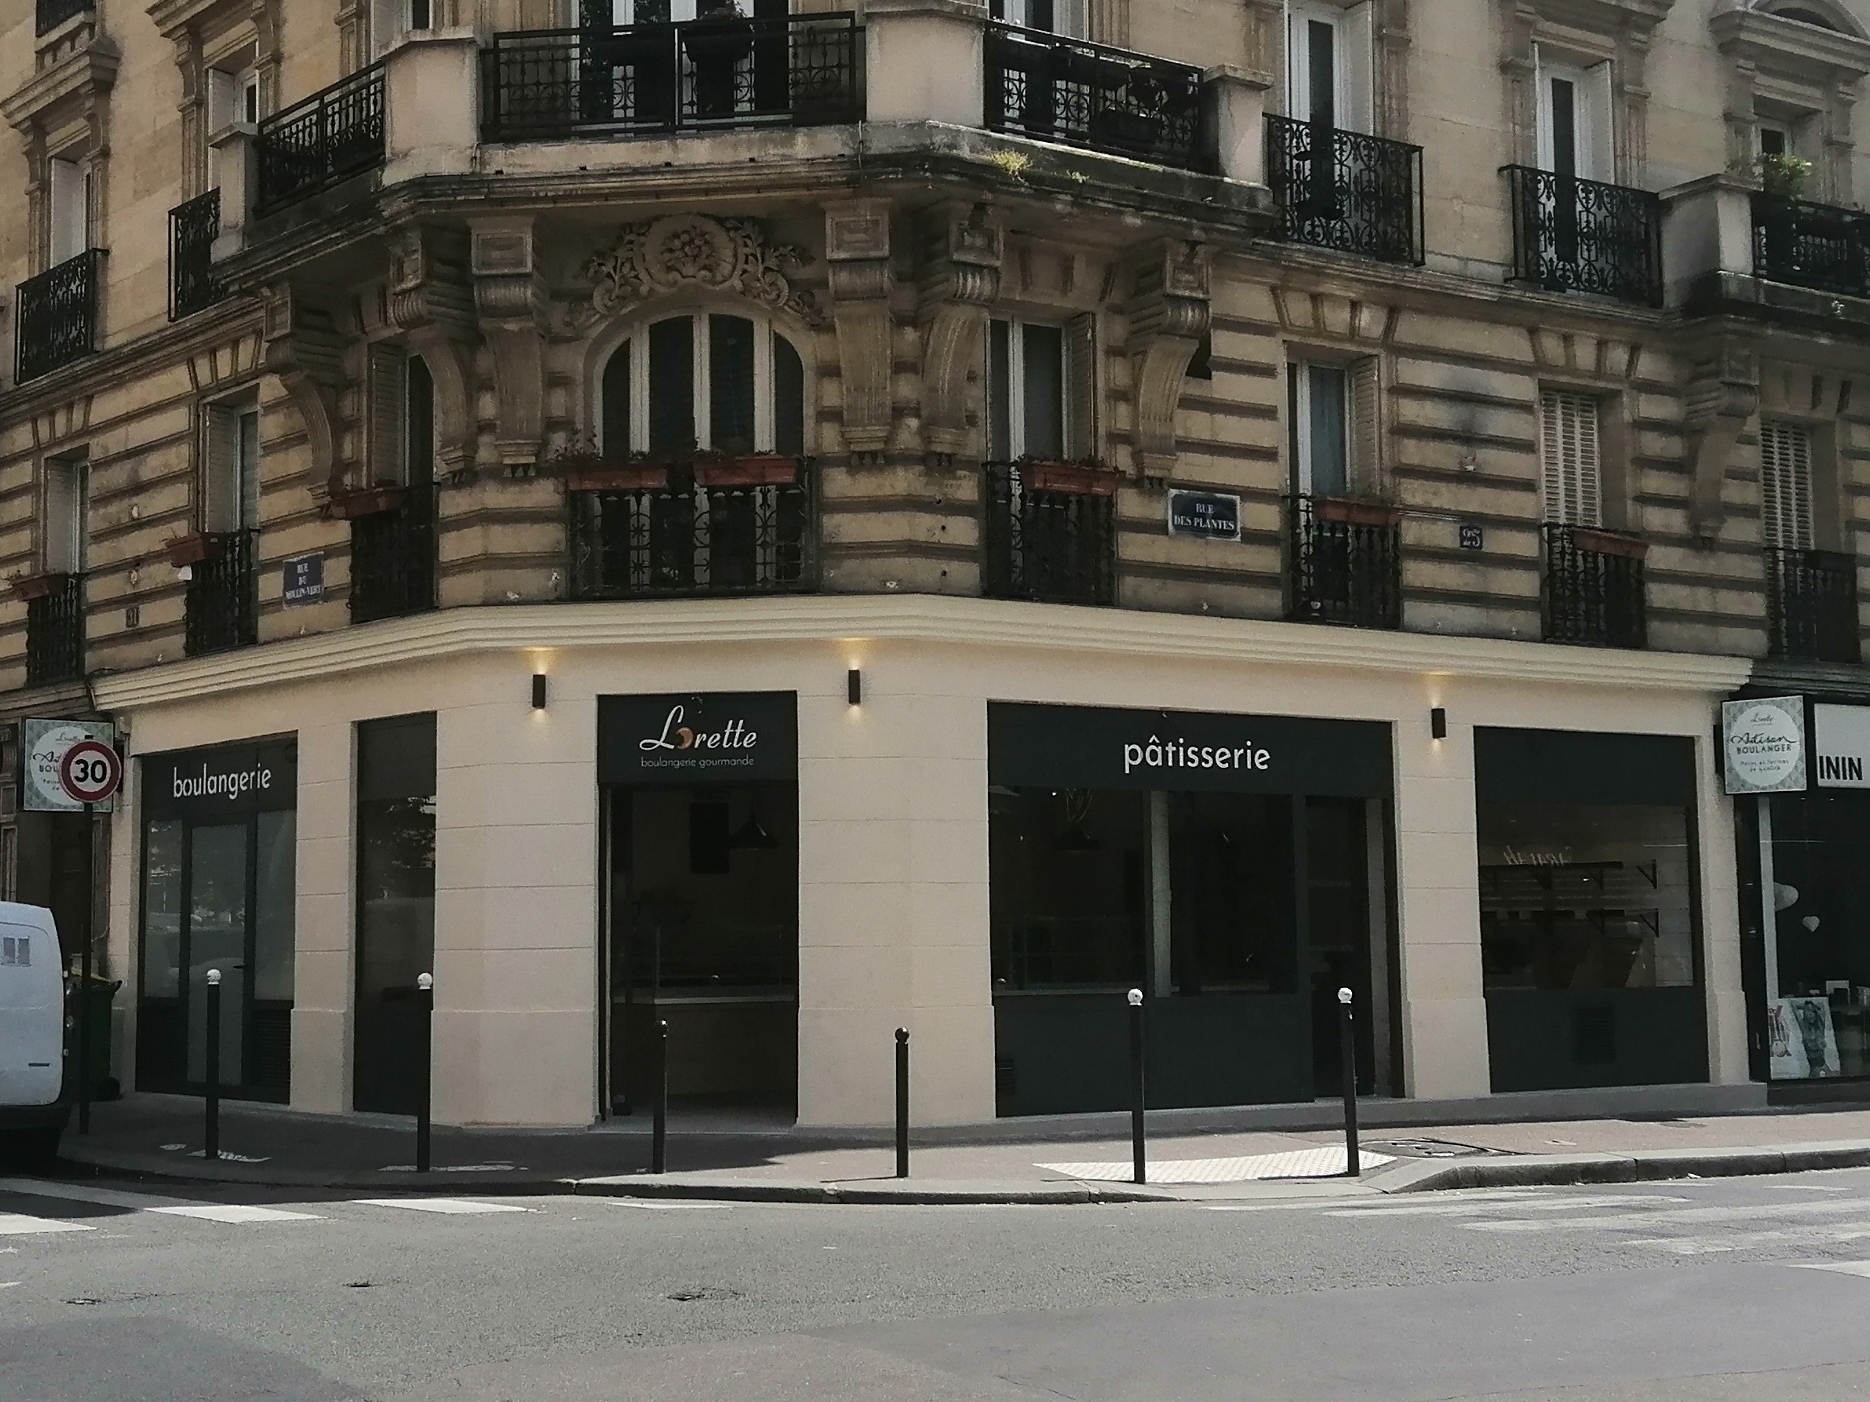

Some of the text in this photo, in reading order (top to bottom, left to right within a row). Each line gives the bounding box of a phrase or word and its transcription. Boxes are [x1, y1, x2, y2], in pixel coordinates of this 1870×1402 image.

[1195, 503, 1214, 514] RUE
[1174, 515, 1235, 530] DES PLANTES
[297, 562, 309, 574] RUE
[639, 705, 757, 751] Lorette
[1730, 732, 1797, 745] Artisan
[1124, 734, 1271, 774] pâtisserie
[1736, 743, 1792, 755] BOULANGER
[640, 754, 755, 769] boulangerie gourmande
[73, 758, 108, 784] 30
[173, 762, 272, 800] boulangerie
